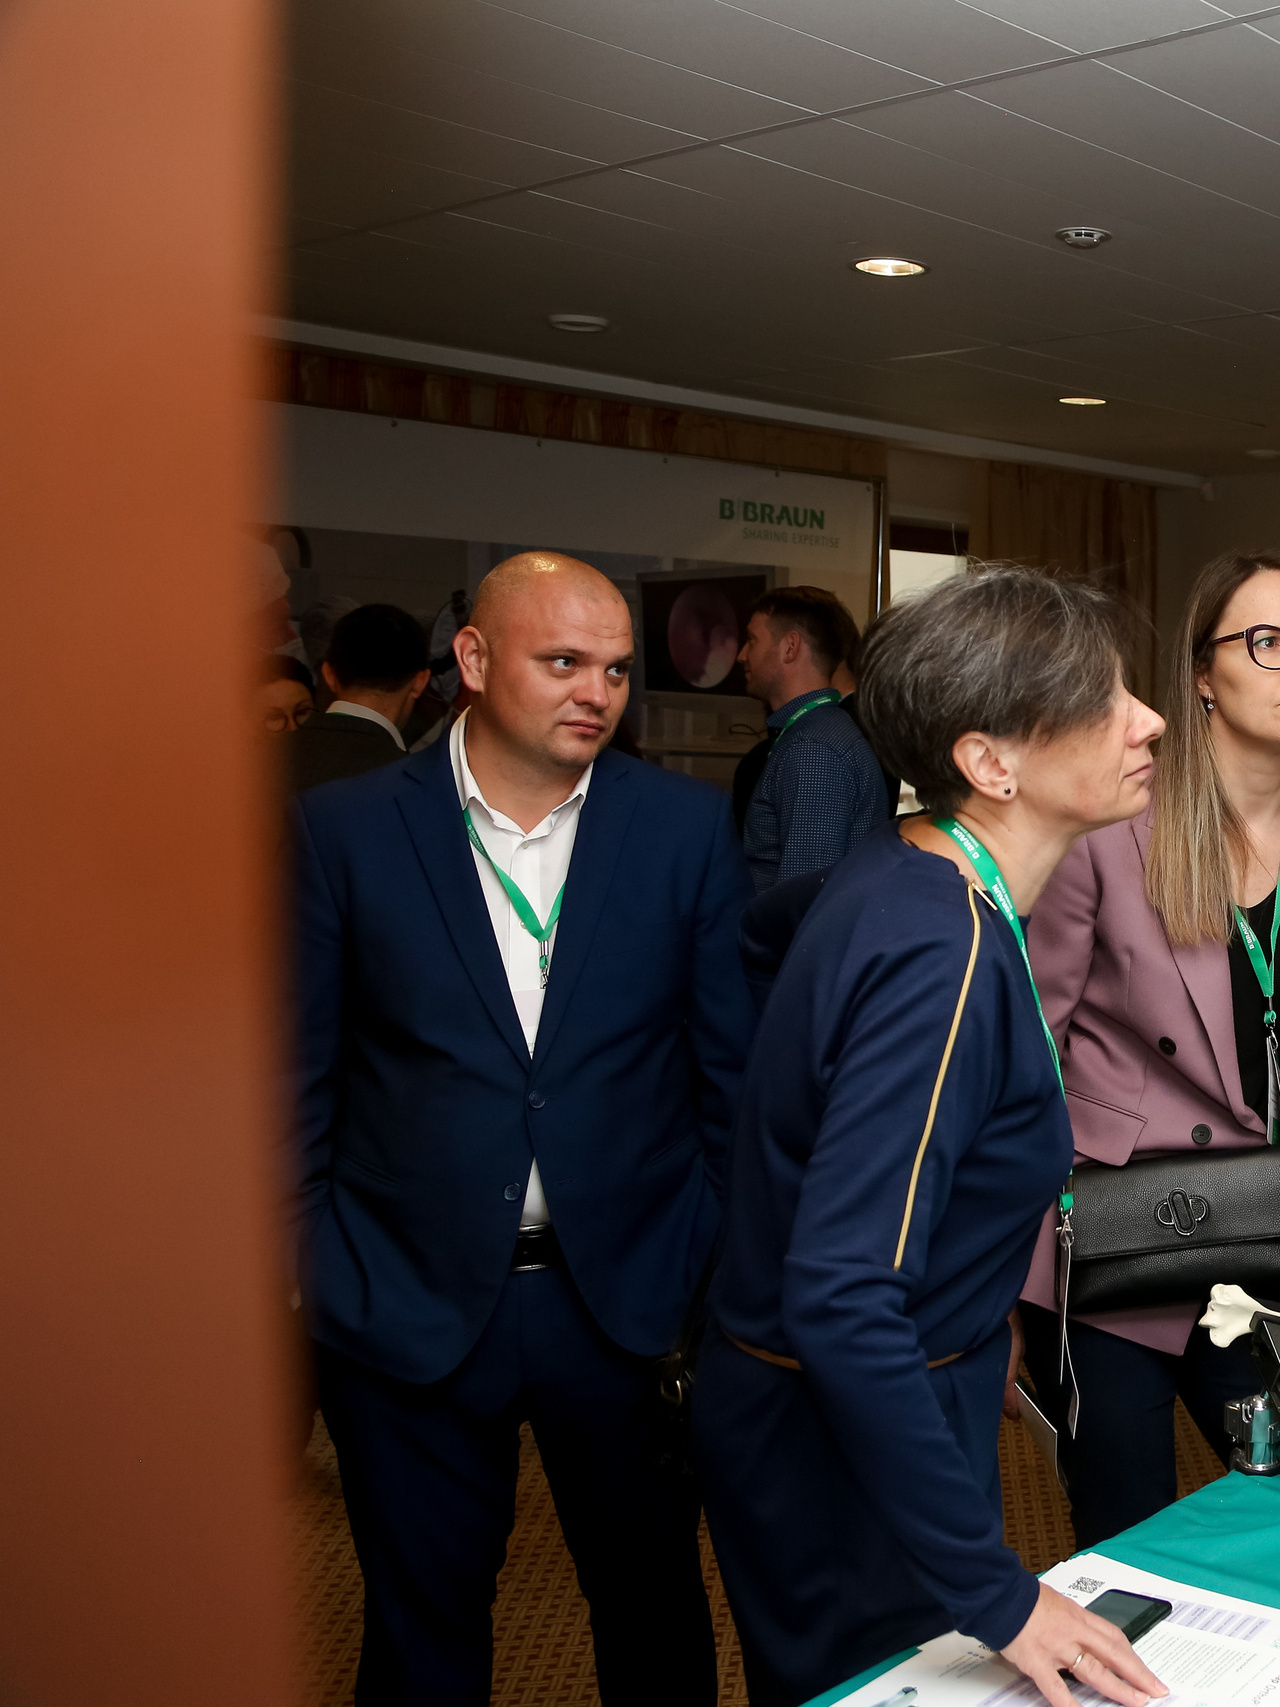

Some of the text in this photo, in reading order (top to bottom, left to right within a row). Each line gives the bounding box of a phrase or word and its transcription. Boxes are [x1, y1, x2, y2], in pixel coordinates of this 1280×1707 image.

[719, 497, 825, 530] B BRAUN
[743, 527, 840, 549] SHARING EXPERTISE
